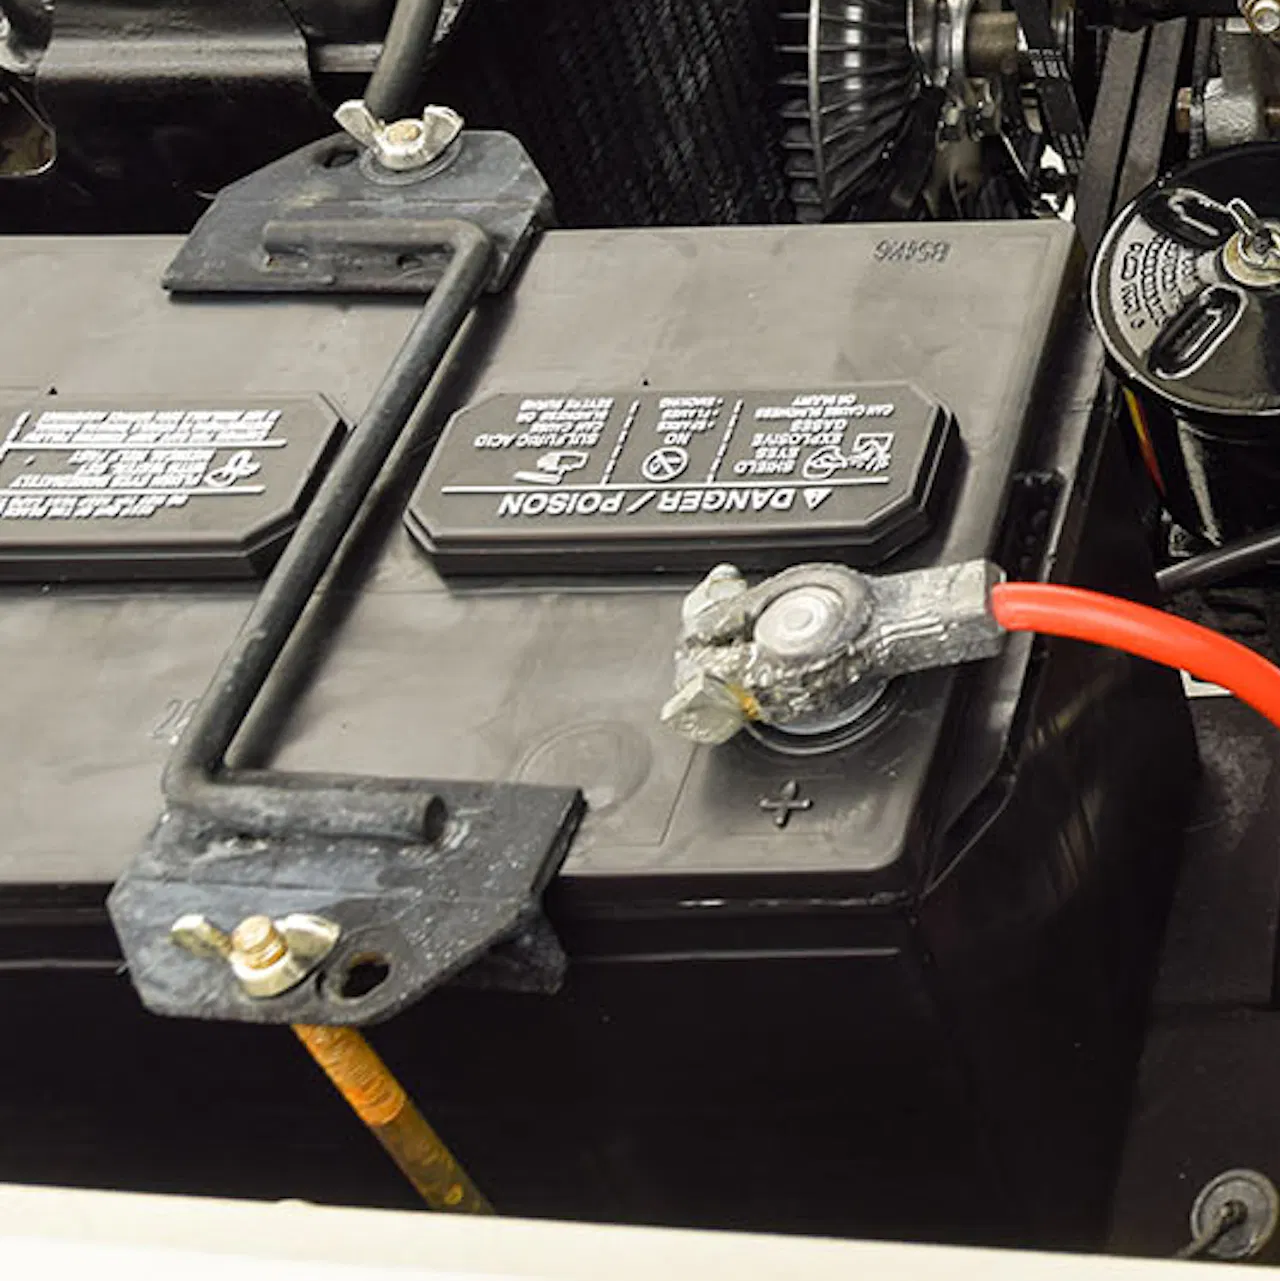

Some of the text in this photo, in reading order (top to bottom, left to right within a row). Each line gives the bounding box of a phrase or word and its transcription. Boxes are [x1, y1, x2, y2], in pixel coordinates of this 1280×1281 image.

[474, 432, 599, 448] SULFURIC ACID
[663, 432, 691, 446] NO
[751, 432, 844, 447] EXPLOSIVE
[755, 446, 801, 460] EYES
[734, 458, 797, 475] SHIELD
[498, 490, 625, 516] POISON
[656, 488, 797, 513] DANGER
